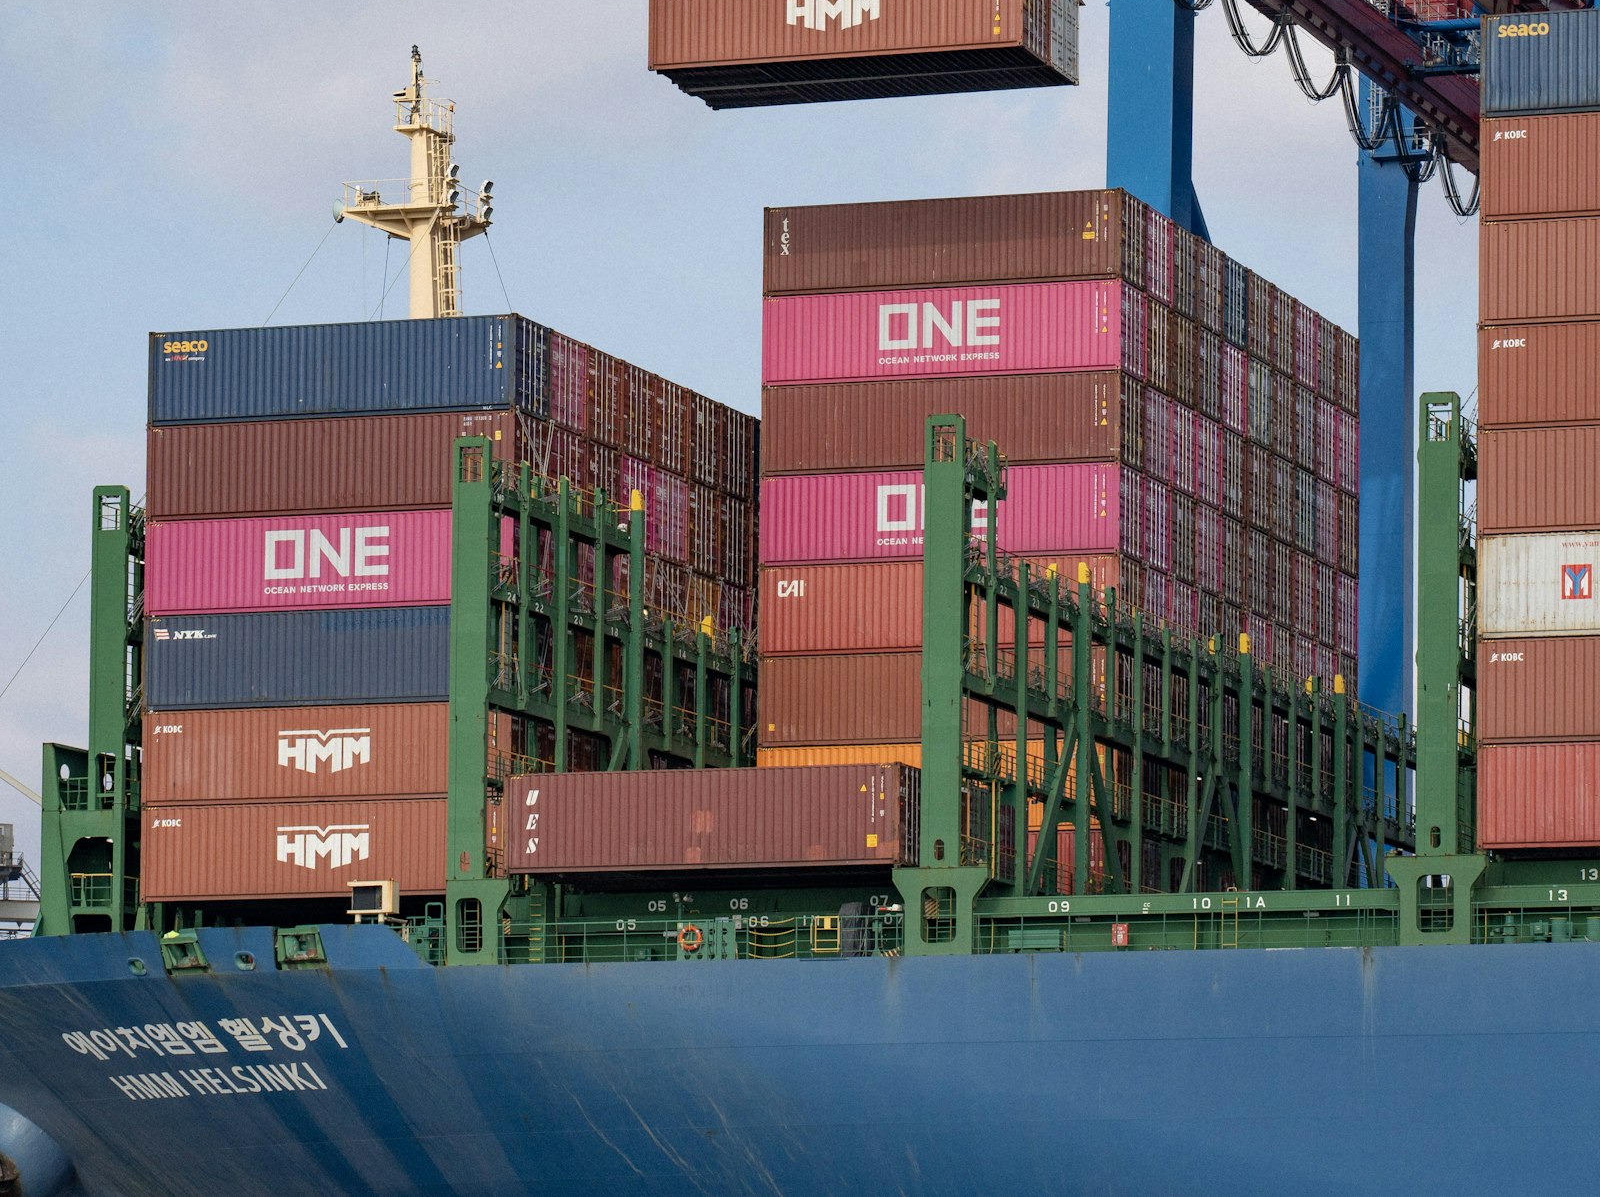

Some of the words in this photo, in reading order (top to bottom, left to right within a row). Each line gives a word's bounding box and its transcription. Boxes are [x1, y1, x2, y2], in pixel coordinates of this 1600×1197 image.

[1498, 22, 1549, 37] seaco
[1504, 129, 1527, 140] KOBC
[780, 217, 791, 256] tex
[879, 298, 1001, 351] ONE
[163, 339, 209, 354] seaco
[1502, 338, 1526, 348] KOBC
[878, 356, 910, 365] OCEAN
[913, 353, 958, 363] NETWORK
[960, 351, 1000, 361] EXPRESS
[877, 537, 908, 546] OCEAN
[264, 525, 390, 580] ONE
[264, 586, 296, 595] OCEAN
[300, 583, 345, 593] NETWORK
[348, 582, 389, 591] EXPRESS
[777, 579, 805, 598] CAI
[507, 591, 517, 603] 24
[535, 602, 544, 613] 22
[173, 630, 205, 641] NYK
[1501, 652, 1524, 662] KOBC
[163, 725, 183, 734] KOBC
[278, 731, 371, 774] HMM
[161, 818, 182, 828] KOBC
[526, 789, 540, 854] UES
[276, 827, 370, 870] HMM
[1580, 868, 1599, 881] 13
[1335, 894, 1350, 907] 11
[1548, 889, 1568, 901] 13
[648, 900, 667, 912] 05
[730, 898, 749, 910] 06
[1048, 900, 1070, 913] 09
[1192, 897, 1211, 910] 10
[1246, 896, 1266, 908] 1A
[616, 919, 637, 931] 05
[748, 915, 769, 928] 06
[62, 1020, 229, 1061] 에이치엠엠
[217, 1013, 349, 1052] 헬싱키
[109, 1071, 191, 1101] HMM
[178, 1061, 329, 1095] HELSINKI
